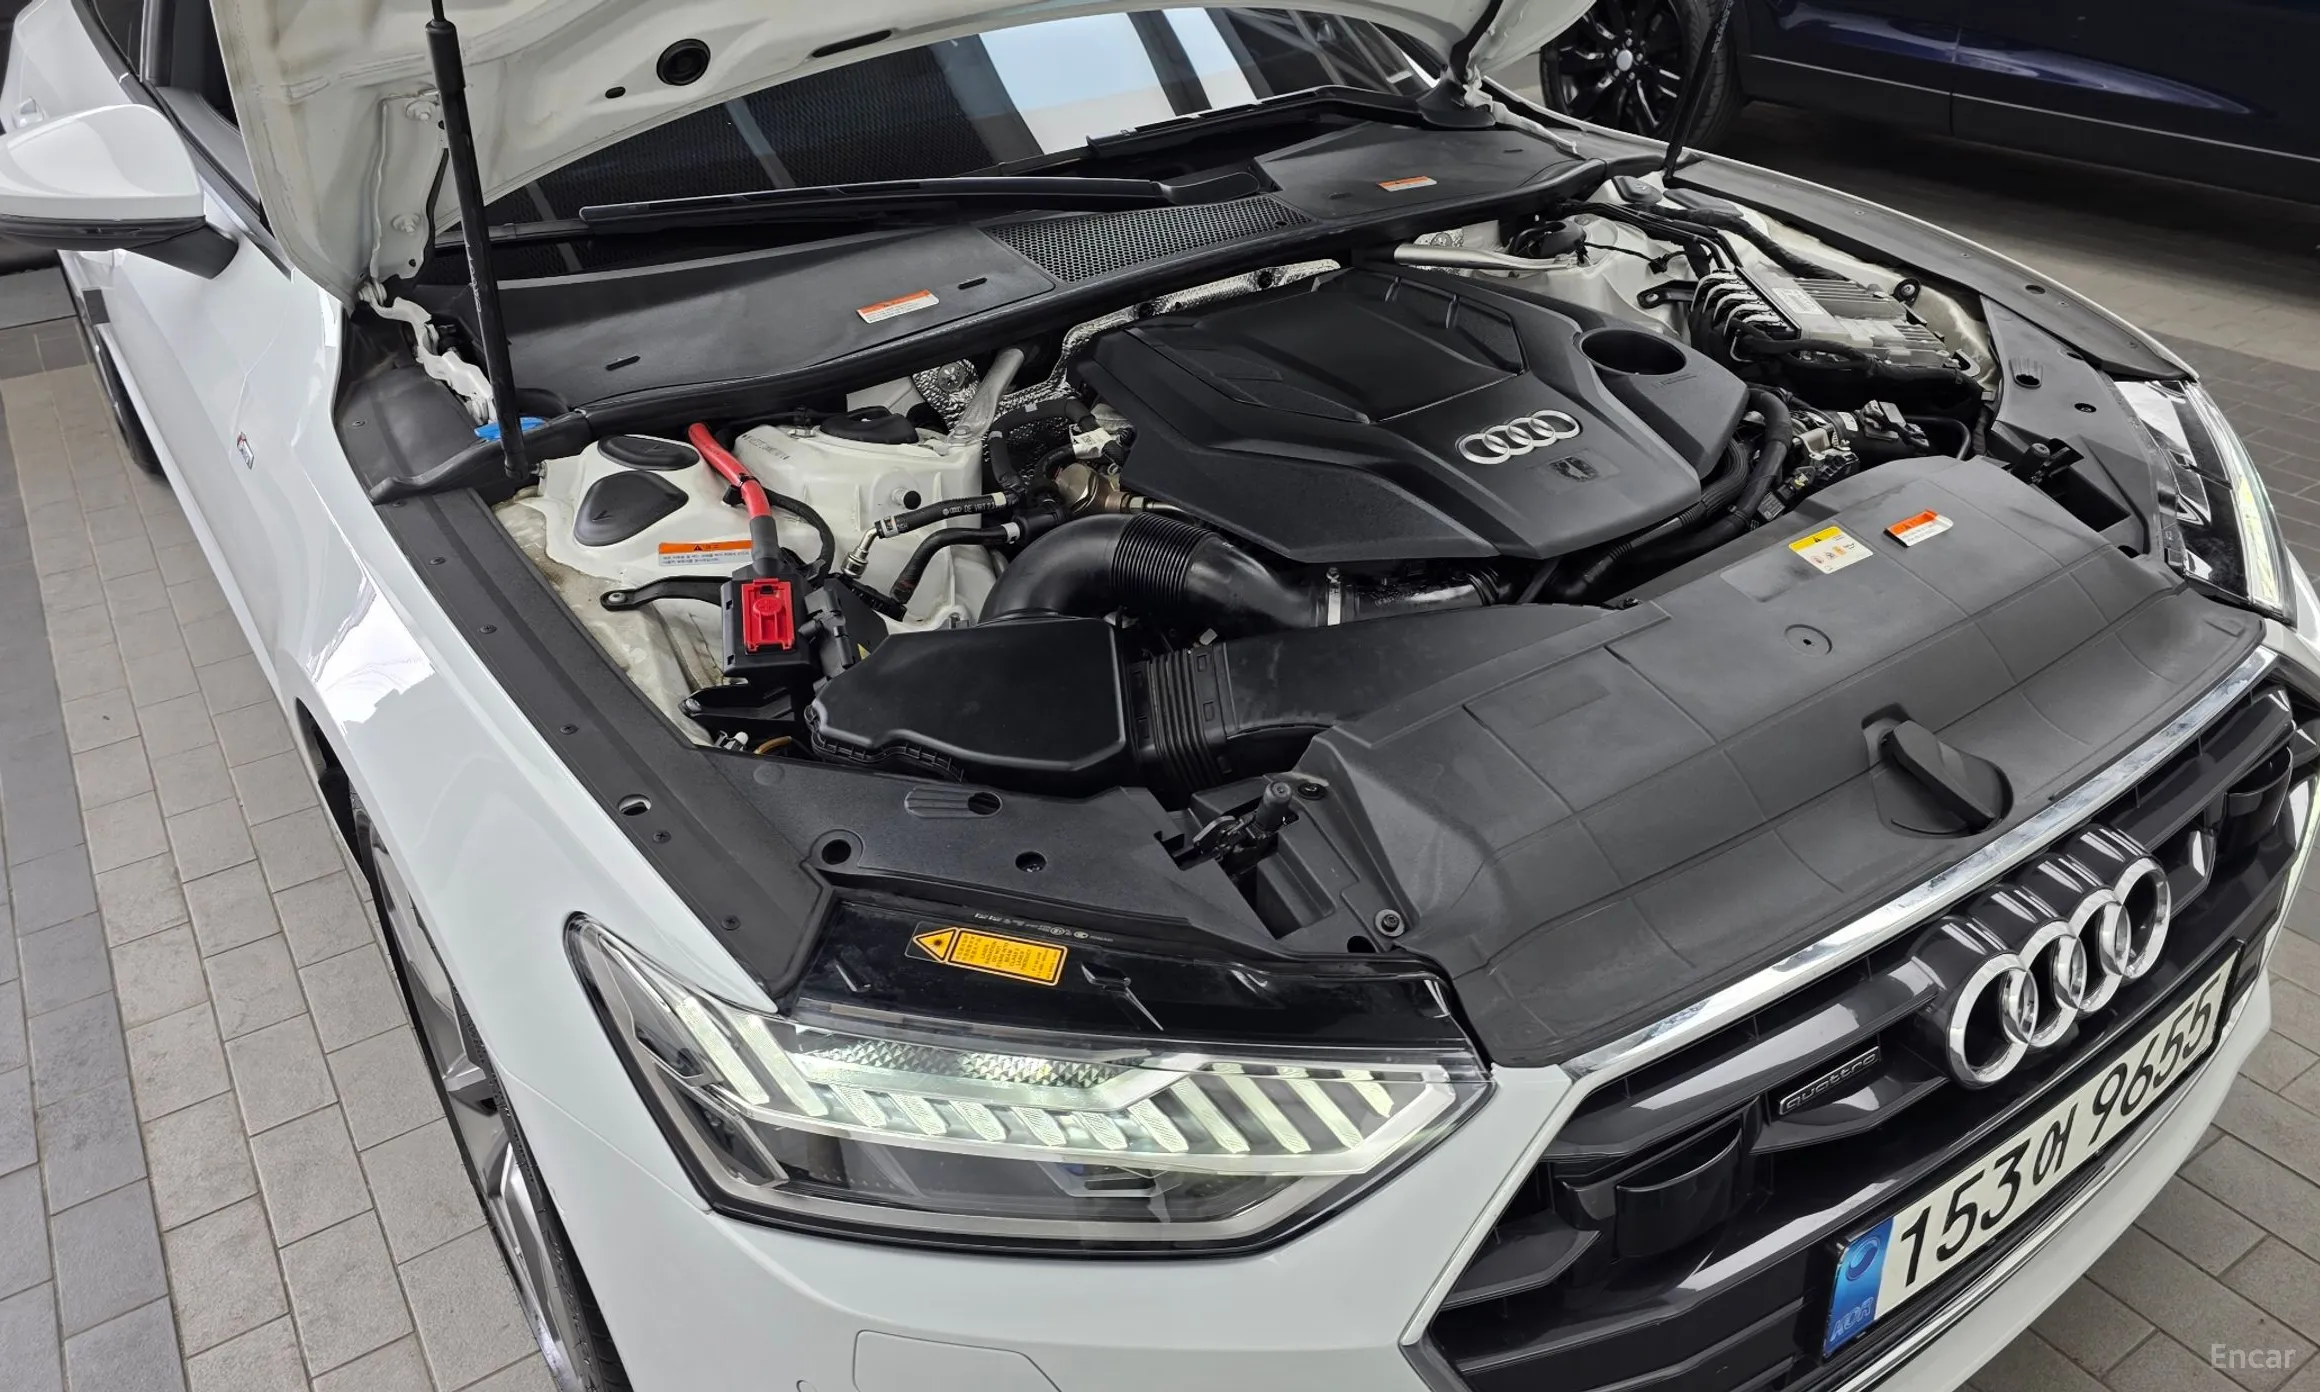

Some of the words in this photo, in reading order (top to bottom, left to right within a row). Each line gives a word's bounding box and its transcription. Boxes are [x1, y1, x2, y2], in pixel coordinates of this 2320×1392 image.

[1786, 1053, 1877, 1109] quattro
[1900, 1103, 2079, 1287] 153어
[2088, 977, 2221, 1147] 9655
